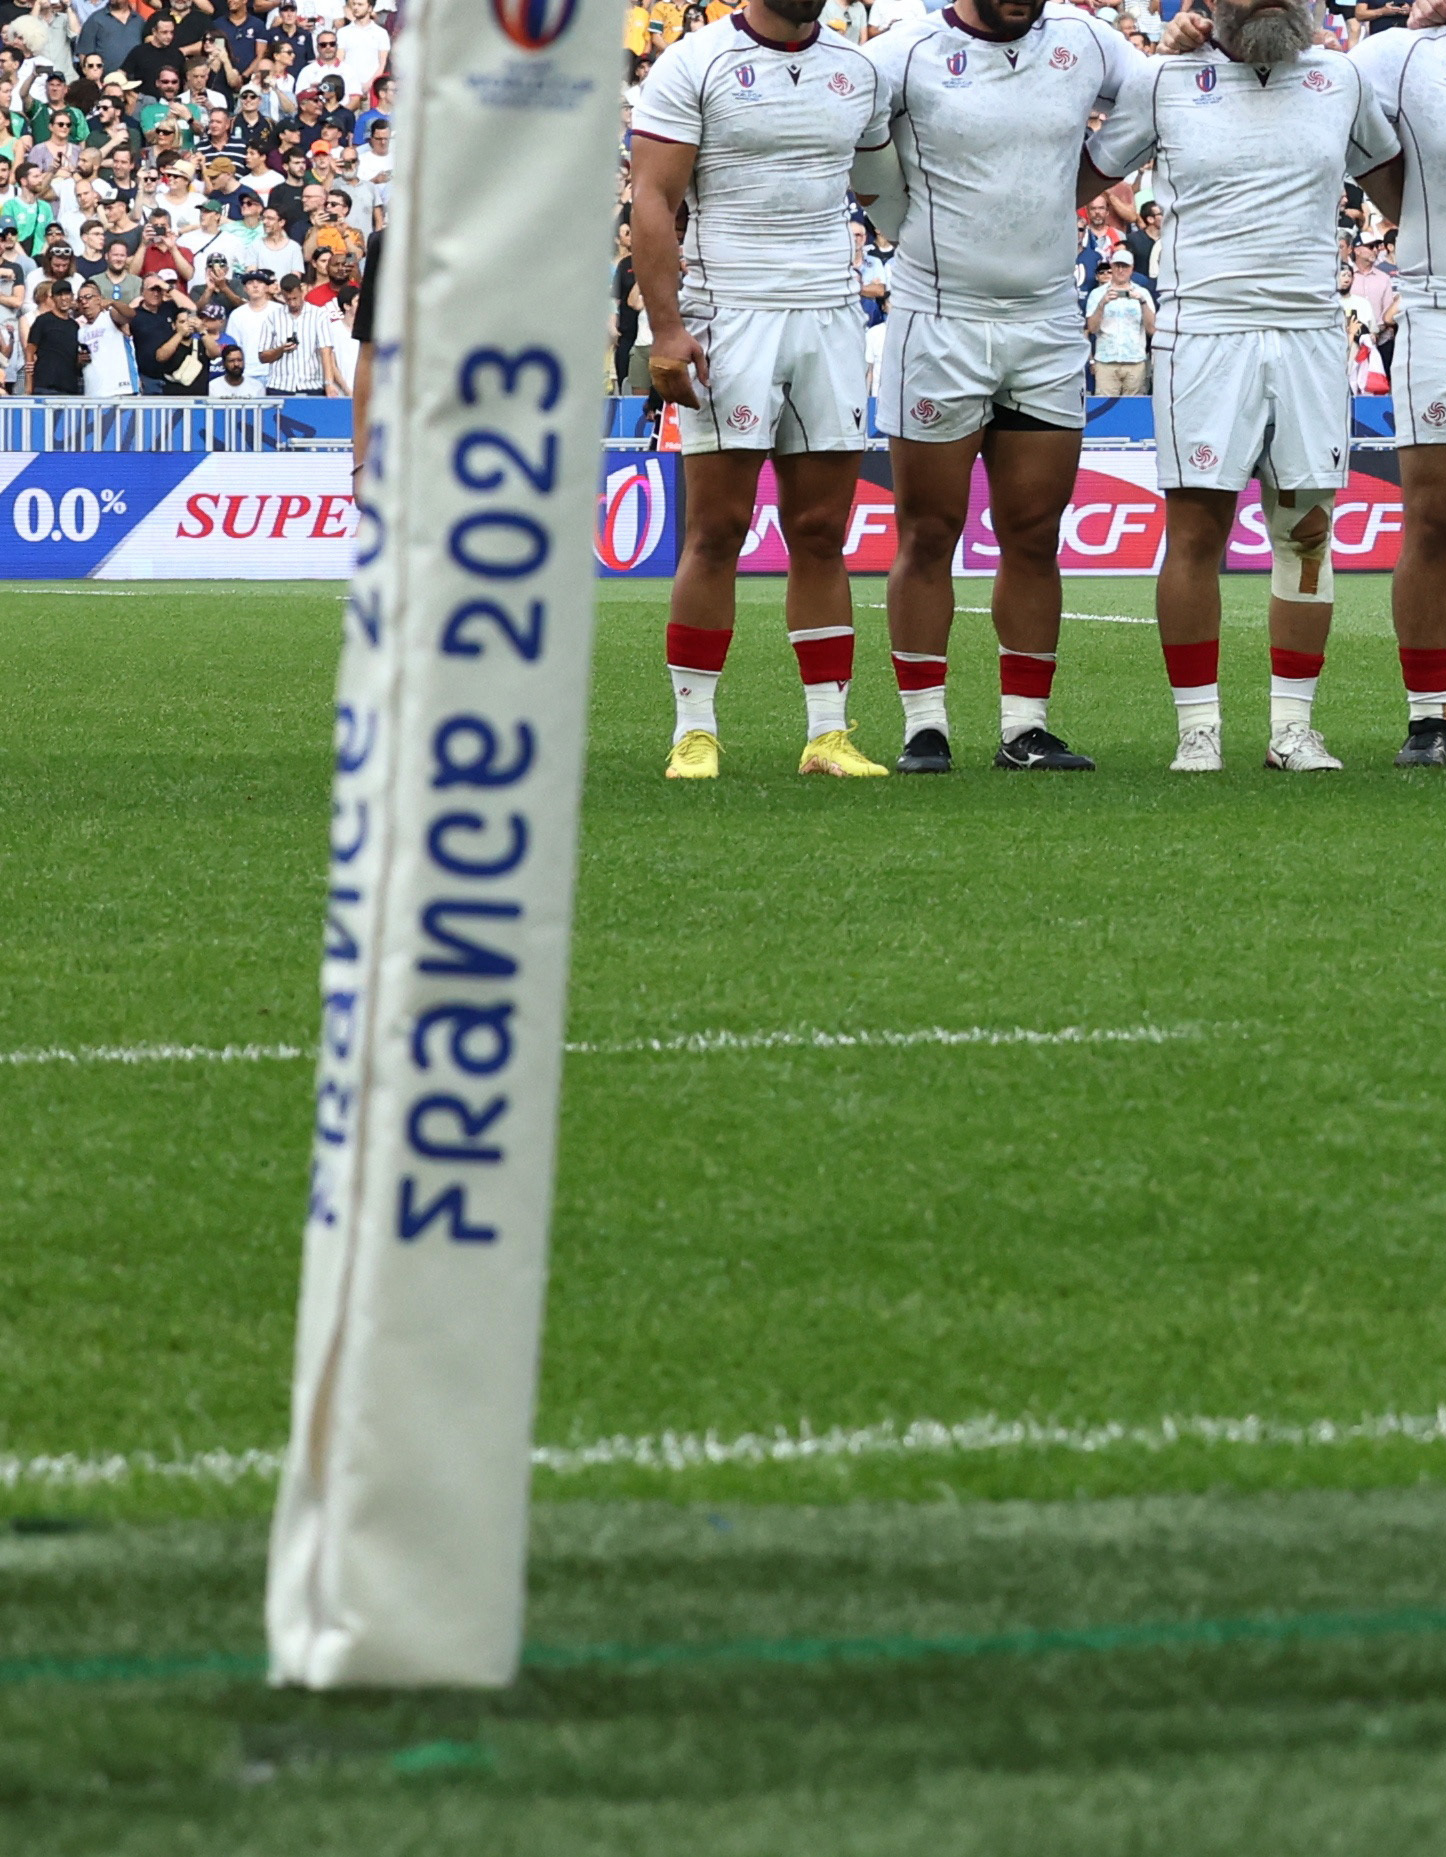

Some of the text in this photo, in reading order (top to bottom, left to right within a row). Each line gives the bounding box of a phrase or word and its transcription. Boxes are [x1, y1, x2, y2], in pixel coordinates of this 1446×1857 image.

[12, 484, 128, 544] 0.0%
[176, 493, 356, 541] SUPE
[439, 346, 563, 662] 2023
